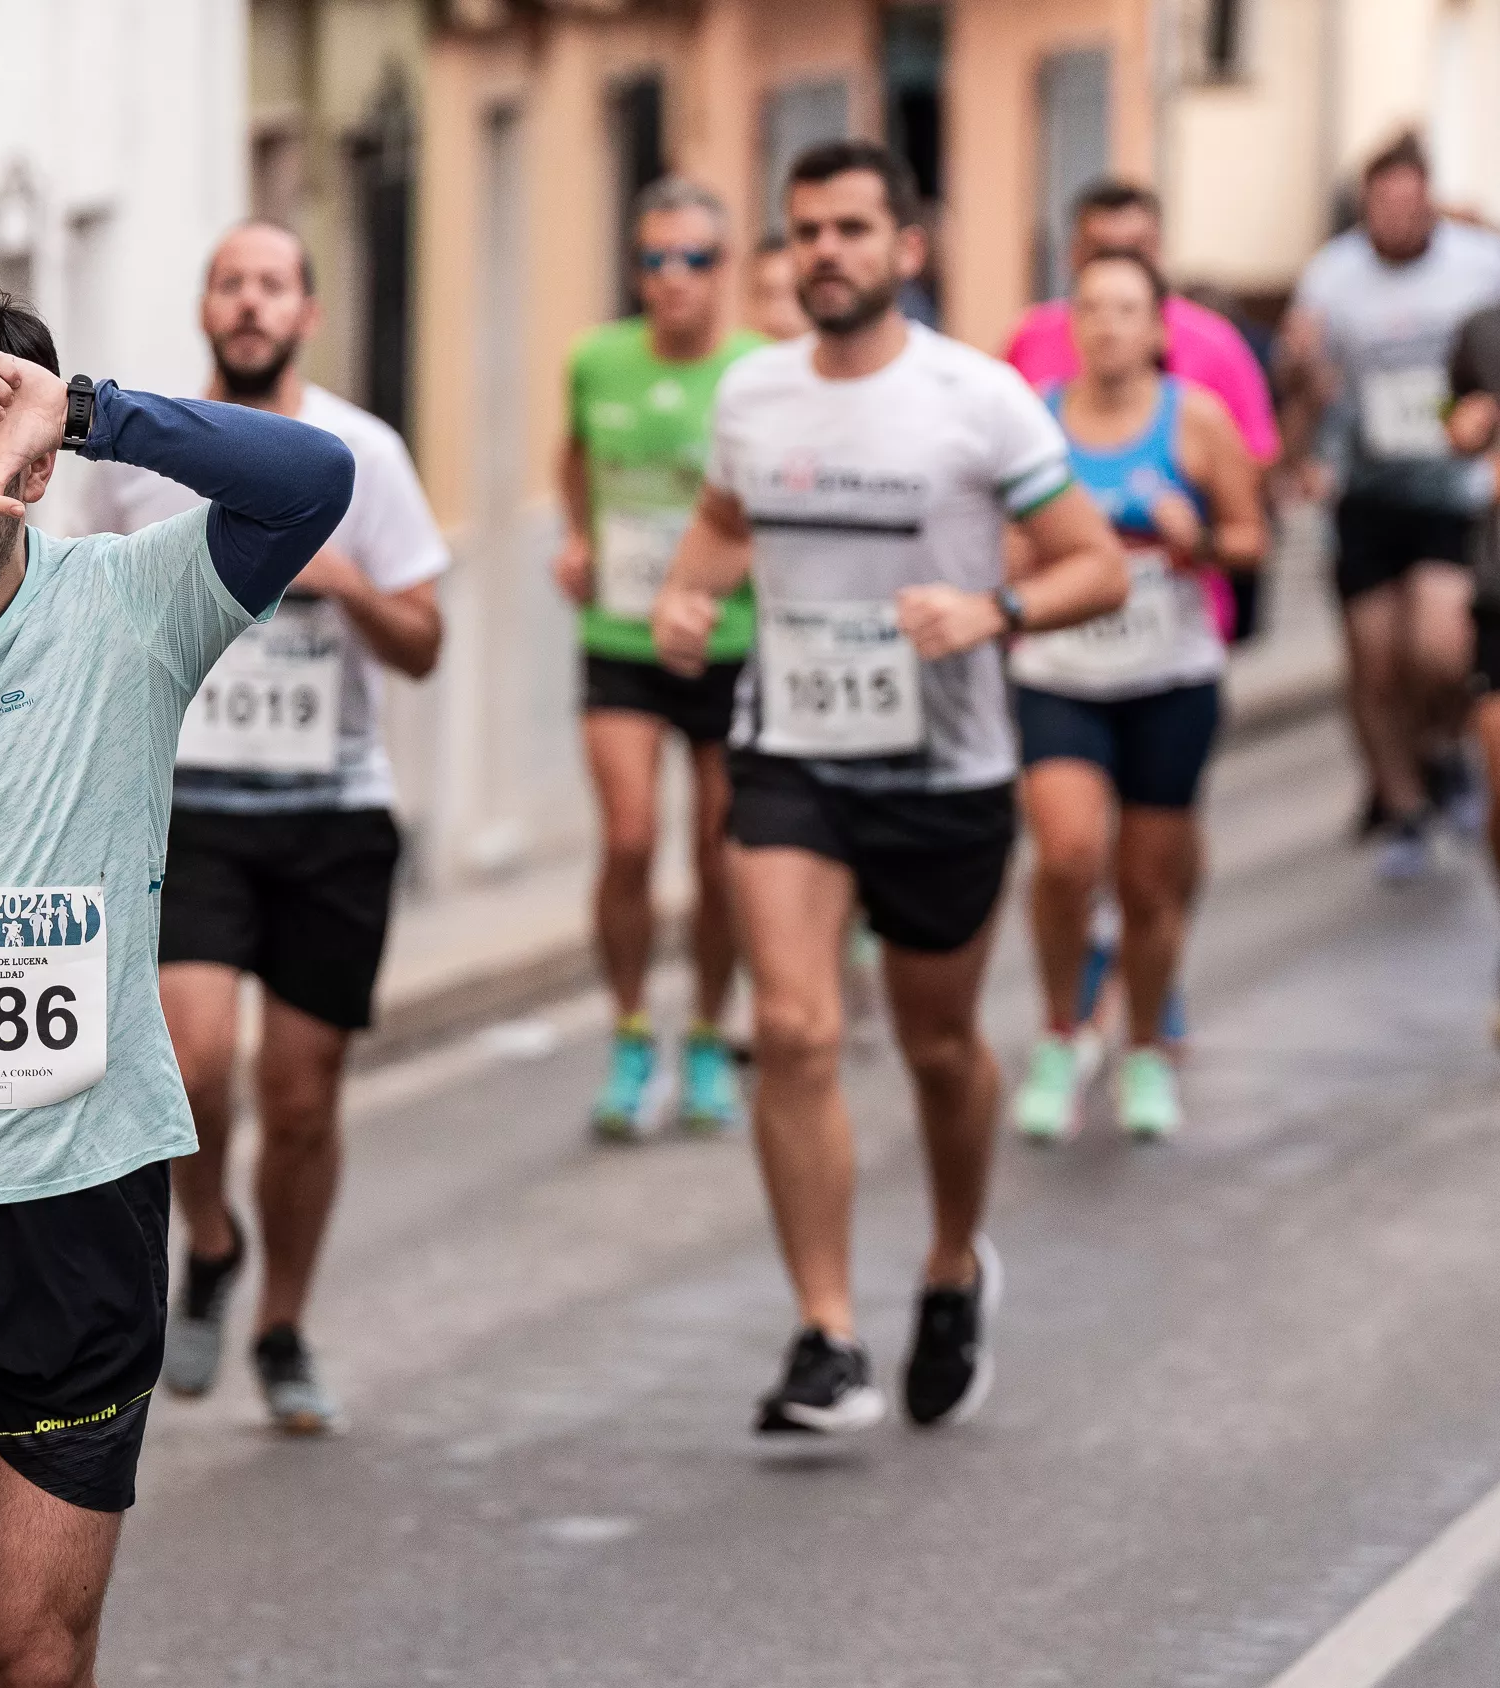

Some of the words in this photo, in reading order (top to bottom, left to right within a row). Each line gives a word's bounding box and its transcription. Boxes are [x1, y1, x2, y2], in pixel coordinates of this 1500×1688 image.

[786, 666, 902, 716] 1015
[203, 682, 320, 730] 1019
[12, 957, 48, 966] LUCENA
[10, 1066, 53, 1077] CORDÓN
